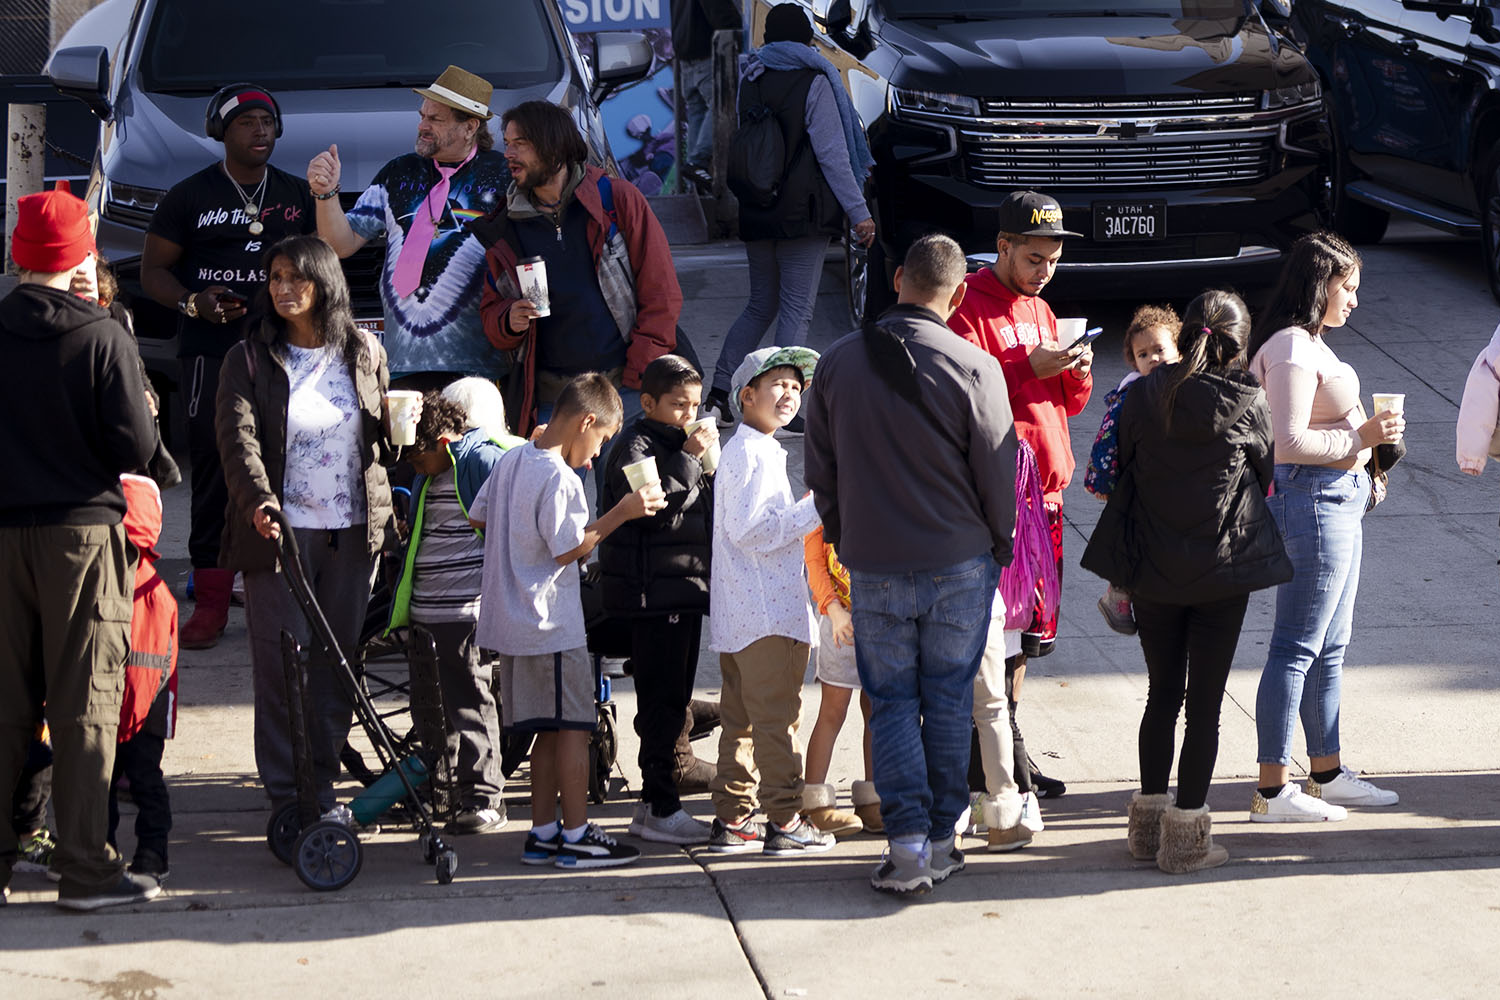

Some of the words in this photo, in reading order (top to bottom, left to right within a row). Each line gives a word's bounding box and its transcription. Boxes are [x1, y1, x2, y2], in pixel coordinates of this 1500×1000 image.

[400, 181, 427, 193] PIN
[1118, 205, 1143, 215] UTAH
[197, 207, 229, 229] WHO
[244, 240, 263, 252] IS
